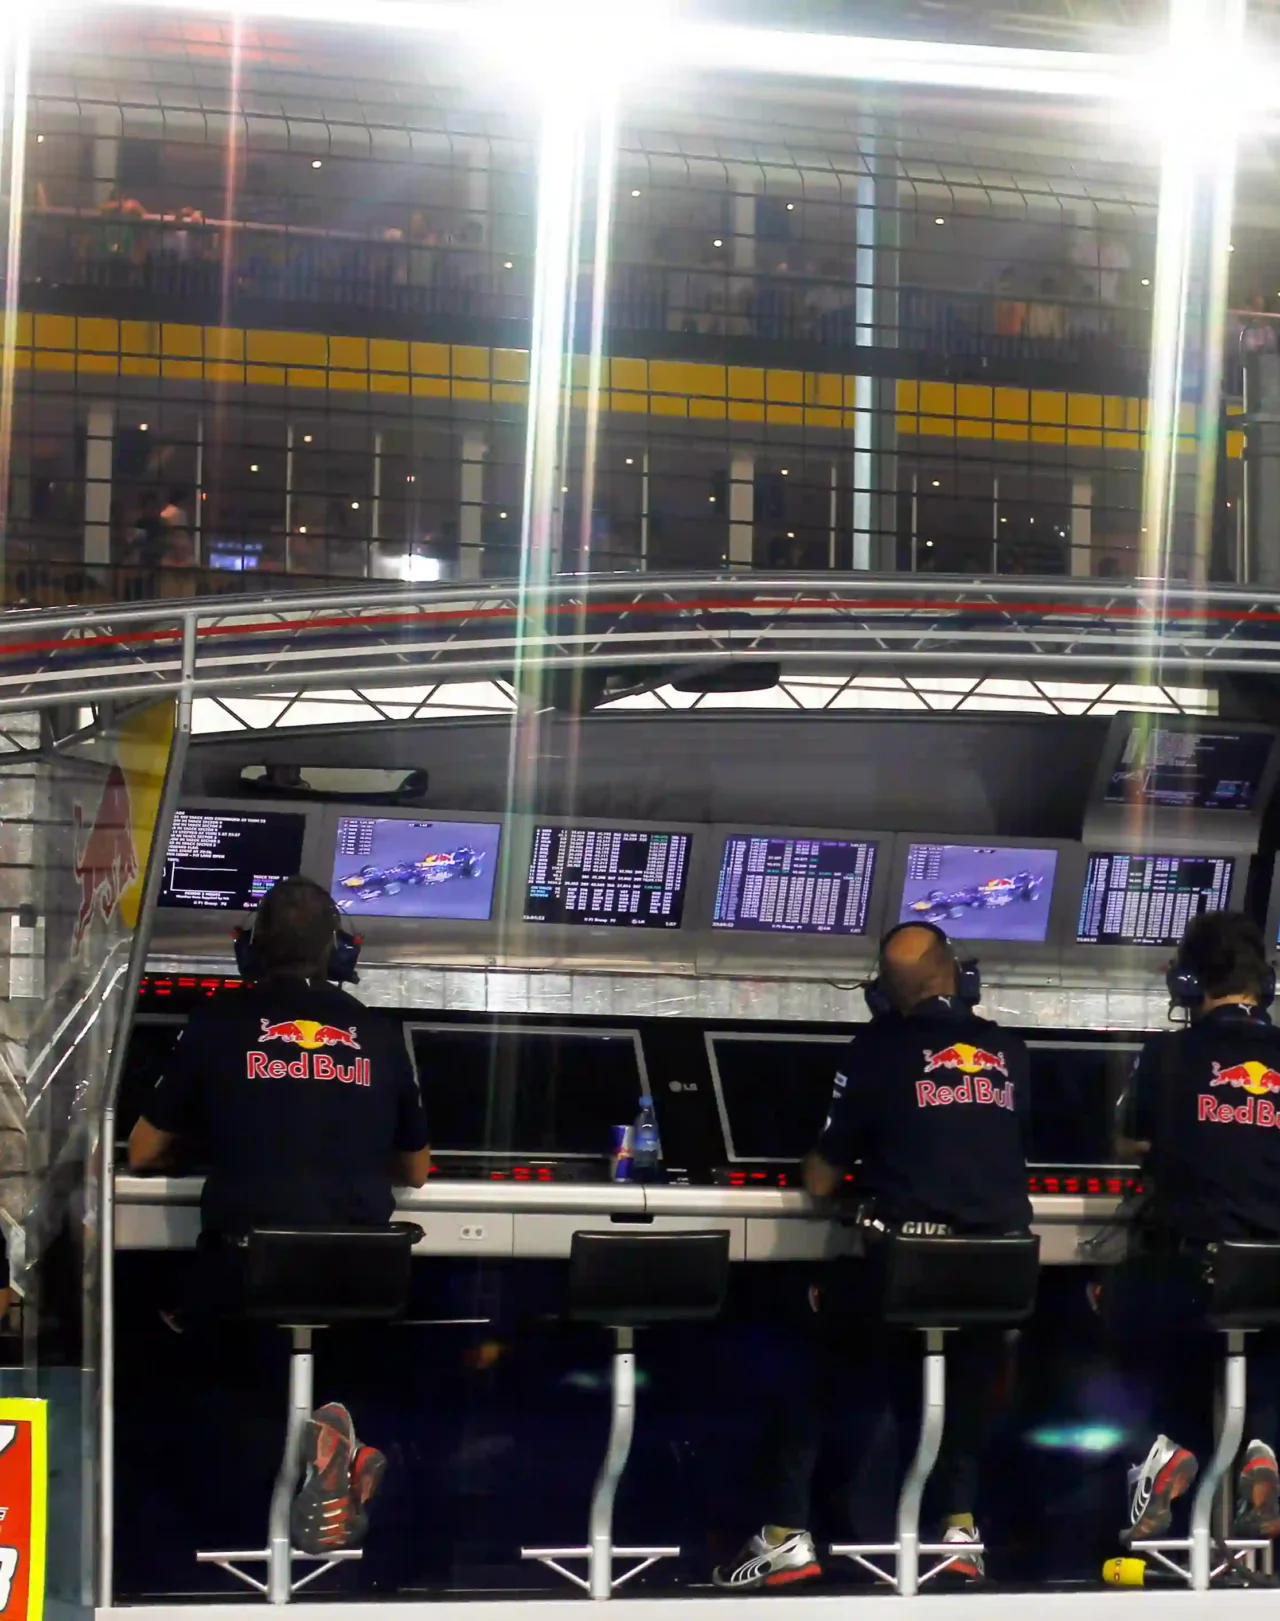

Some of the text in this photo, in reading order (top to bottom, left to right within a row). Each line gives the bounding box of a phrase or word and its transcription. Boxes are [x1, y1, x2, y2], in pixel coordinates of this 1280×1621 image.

[247, 1051, 371, 1086] Red Bull
[916, 1076, 1015, 1111] Red Bull
[1198, 1094, 1253, 1124] Red
